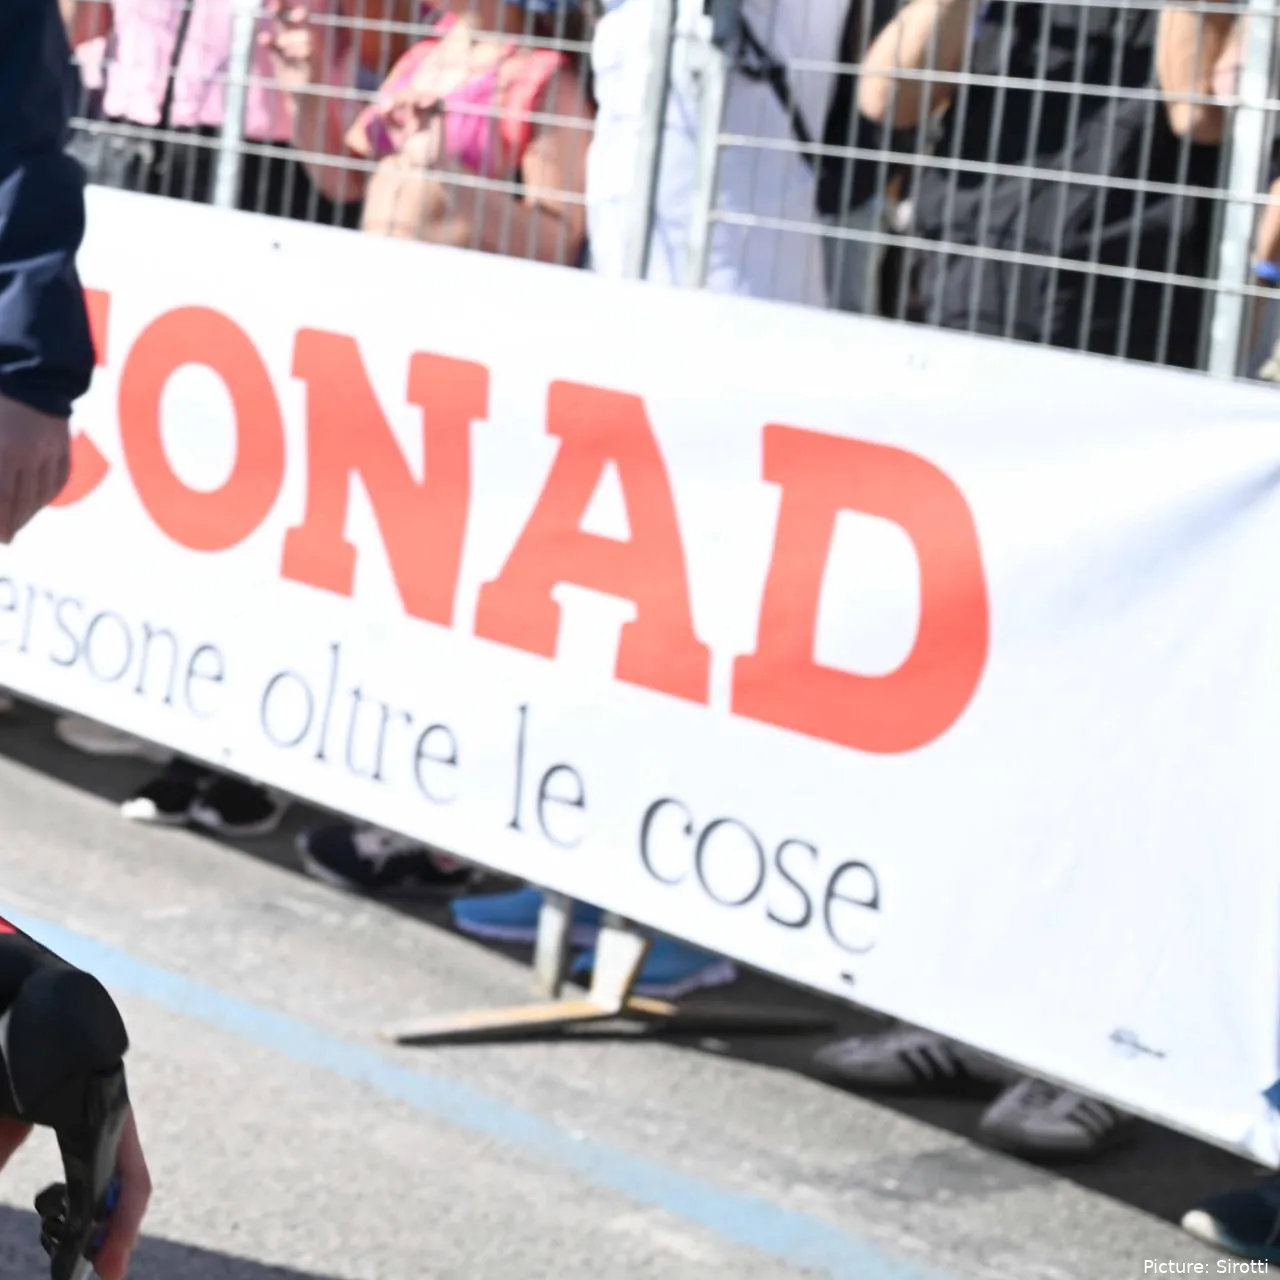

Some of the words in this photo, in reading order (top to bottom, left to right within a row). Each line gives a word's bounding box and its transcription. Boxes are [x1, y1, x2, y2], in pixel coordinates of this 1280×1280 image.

[259, 641, 459, 805] oltre
[507, 704, 587, 849] le
[638, 795, 882, 955] cose
